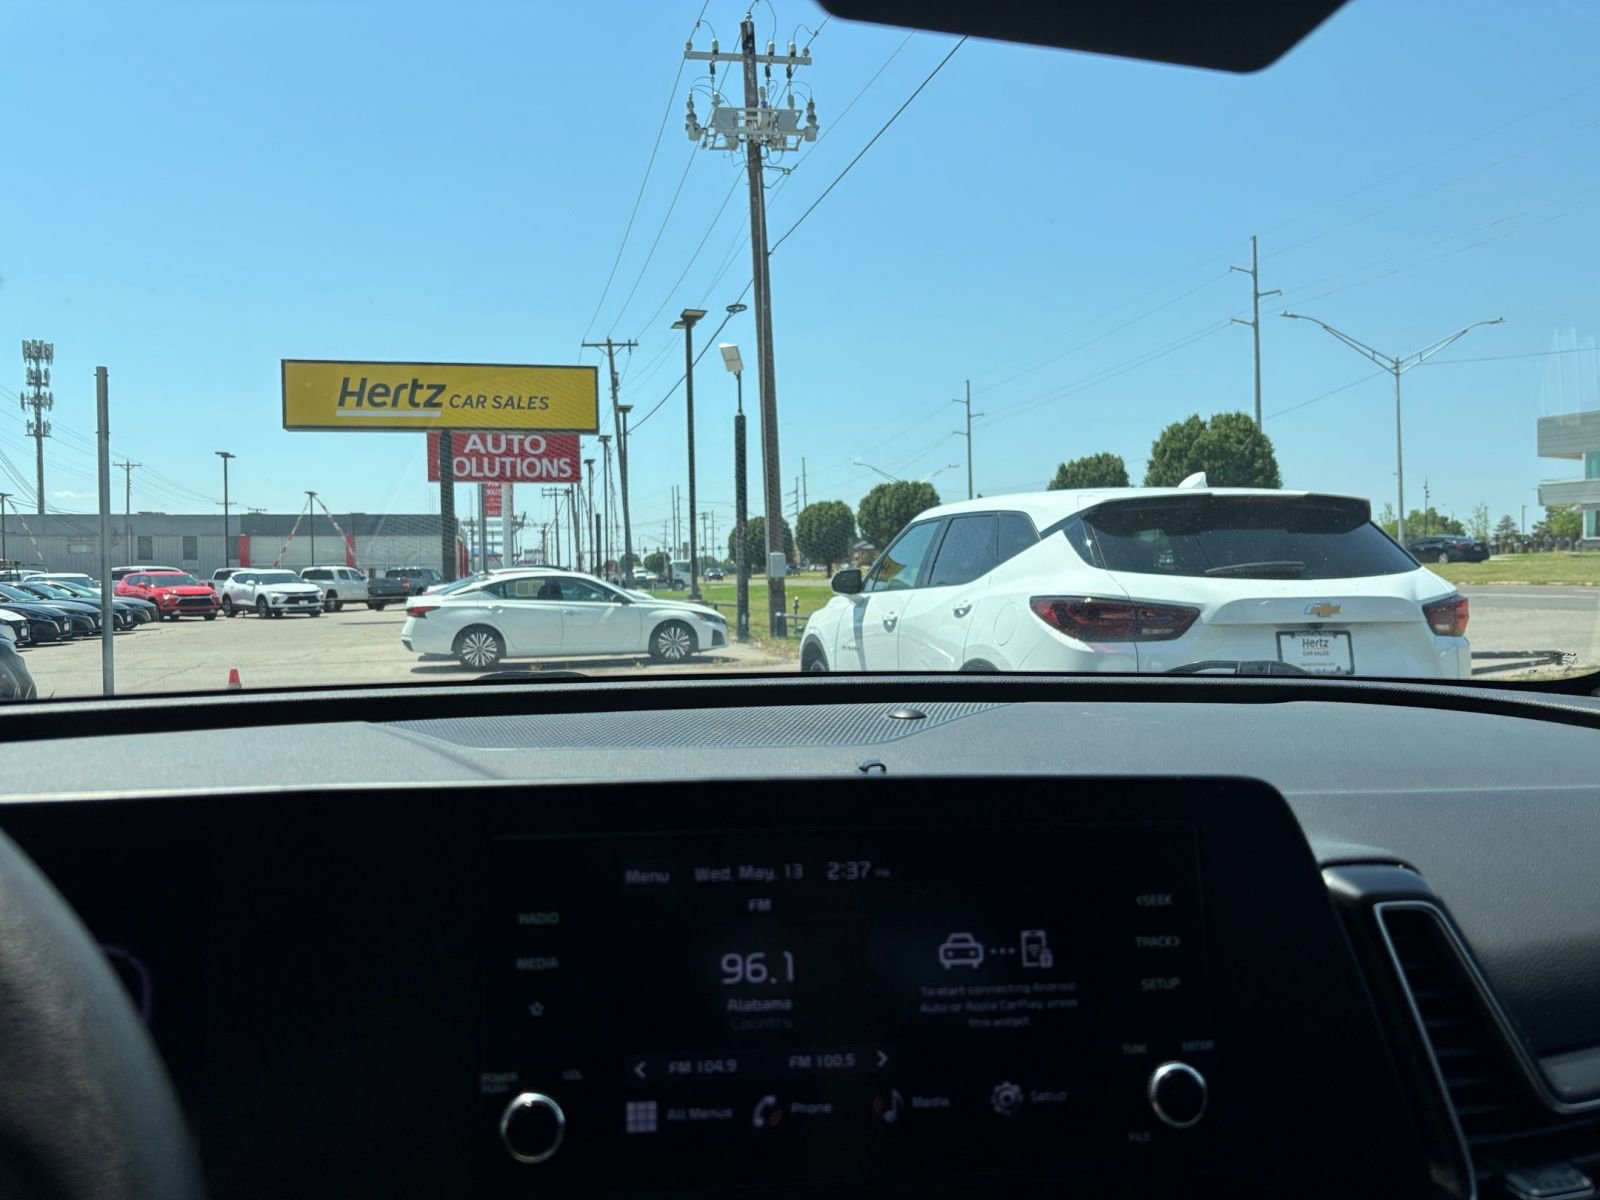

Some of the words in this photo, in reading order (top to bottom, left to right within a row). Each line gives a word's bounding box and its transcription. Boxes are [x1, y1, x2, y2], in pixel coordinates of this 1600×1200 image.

[338, 377, 447, 408] Hertz
[450, 394, 487, 409] CAR
[491, 395, 549, 410] SALES
[464, 434, 547, 455] AUTO
[438, 456, 572, 478] OLUTIONS
[1302, 638, 1329, 648] Hertz
[624, 868, 671, 884] Menu
[784, 863, 804, 880] 13
[826, 860, 872, 881] 2:37
[748, 898, 772, 912] FM
[517, 911, 560, 926] RADIO
[515, 956, 560, 971] MEDIA
[721, 950, 795, 985] 96.1
[1140, 977, 1182, 992] SETUP
[727, 998, 793, 1013] Alabama
[668, 1060, 692, 1074] FM
[696, 1058, 738, 1074] 104.9
[788, 1055, 812, 1069] FM
[816, 1053, 856, 1069] 100.5
[911, 1096, 951, 1109] Media
[1029, 1090, 1069, 1104] Setup
[688, 1106, 734, 1120] Menus
[790, 1102, 833, 1115] Phone
